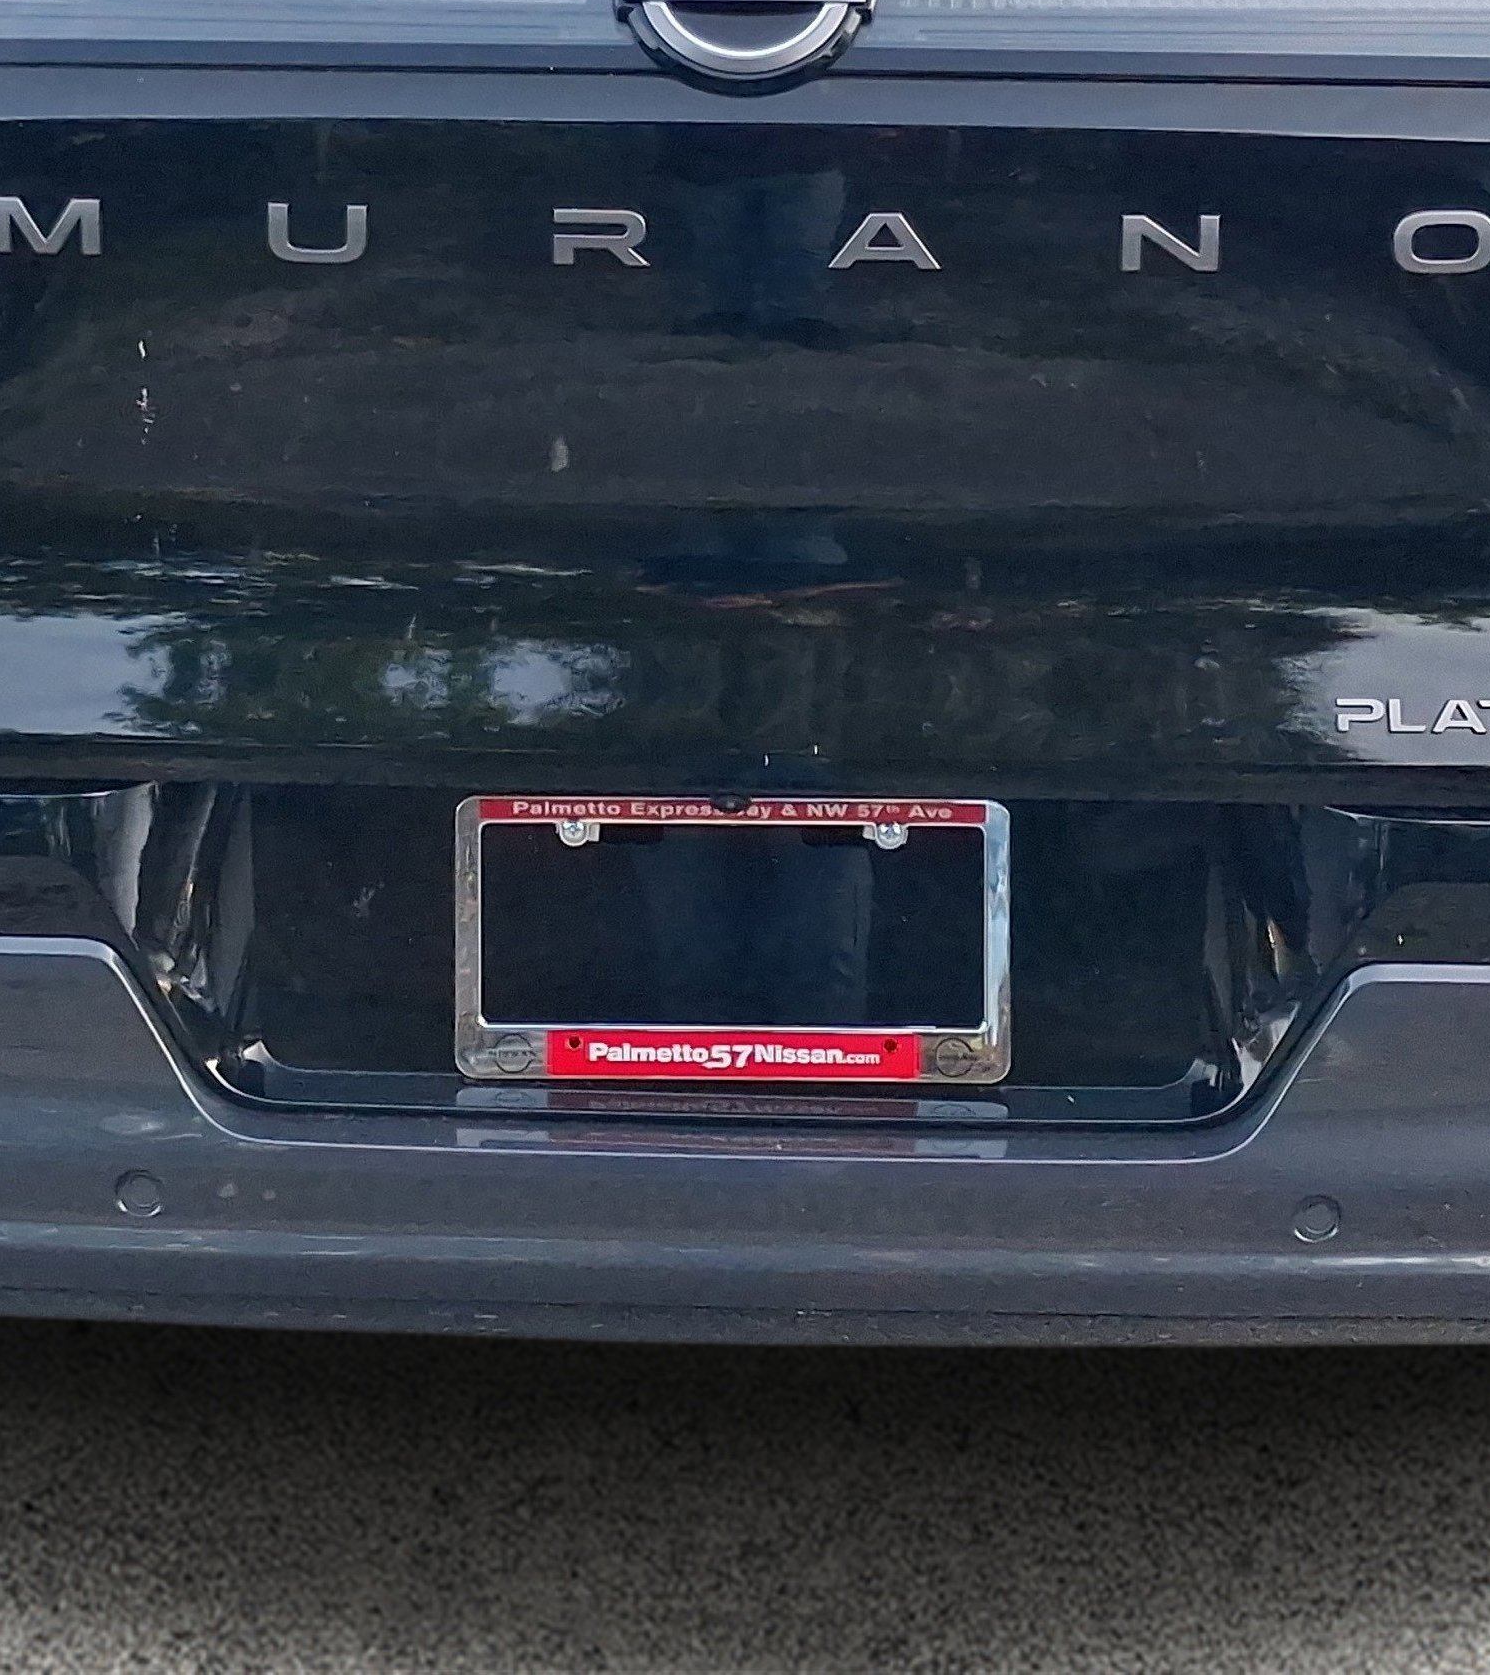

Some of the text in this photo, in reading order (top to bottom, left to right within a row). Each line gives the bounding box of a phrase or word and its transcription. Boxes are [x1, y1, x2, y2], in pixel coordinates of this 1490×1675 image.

[512, 800, 953, 820] Palmetto Expresay & NW 57th Ave
[589, 1042, 880, 1069] Palmetto57Nissan.com
